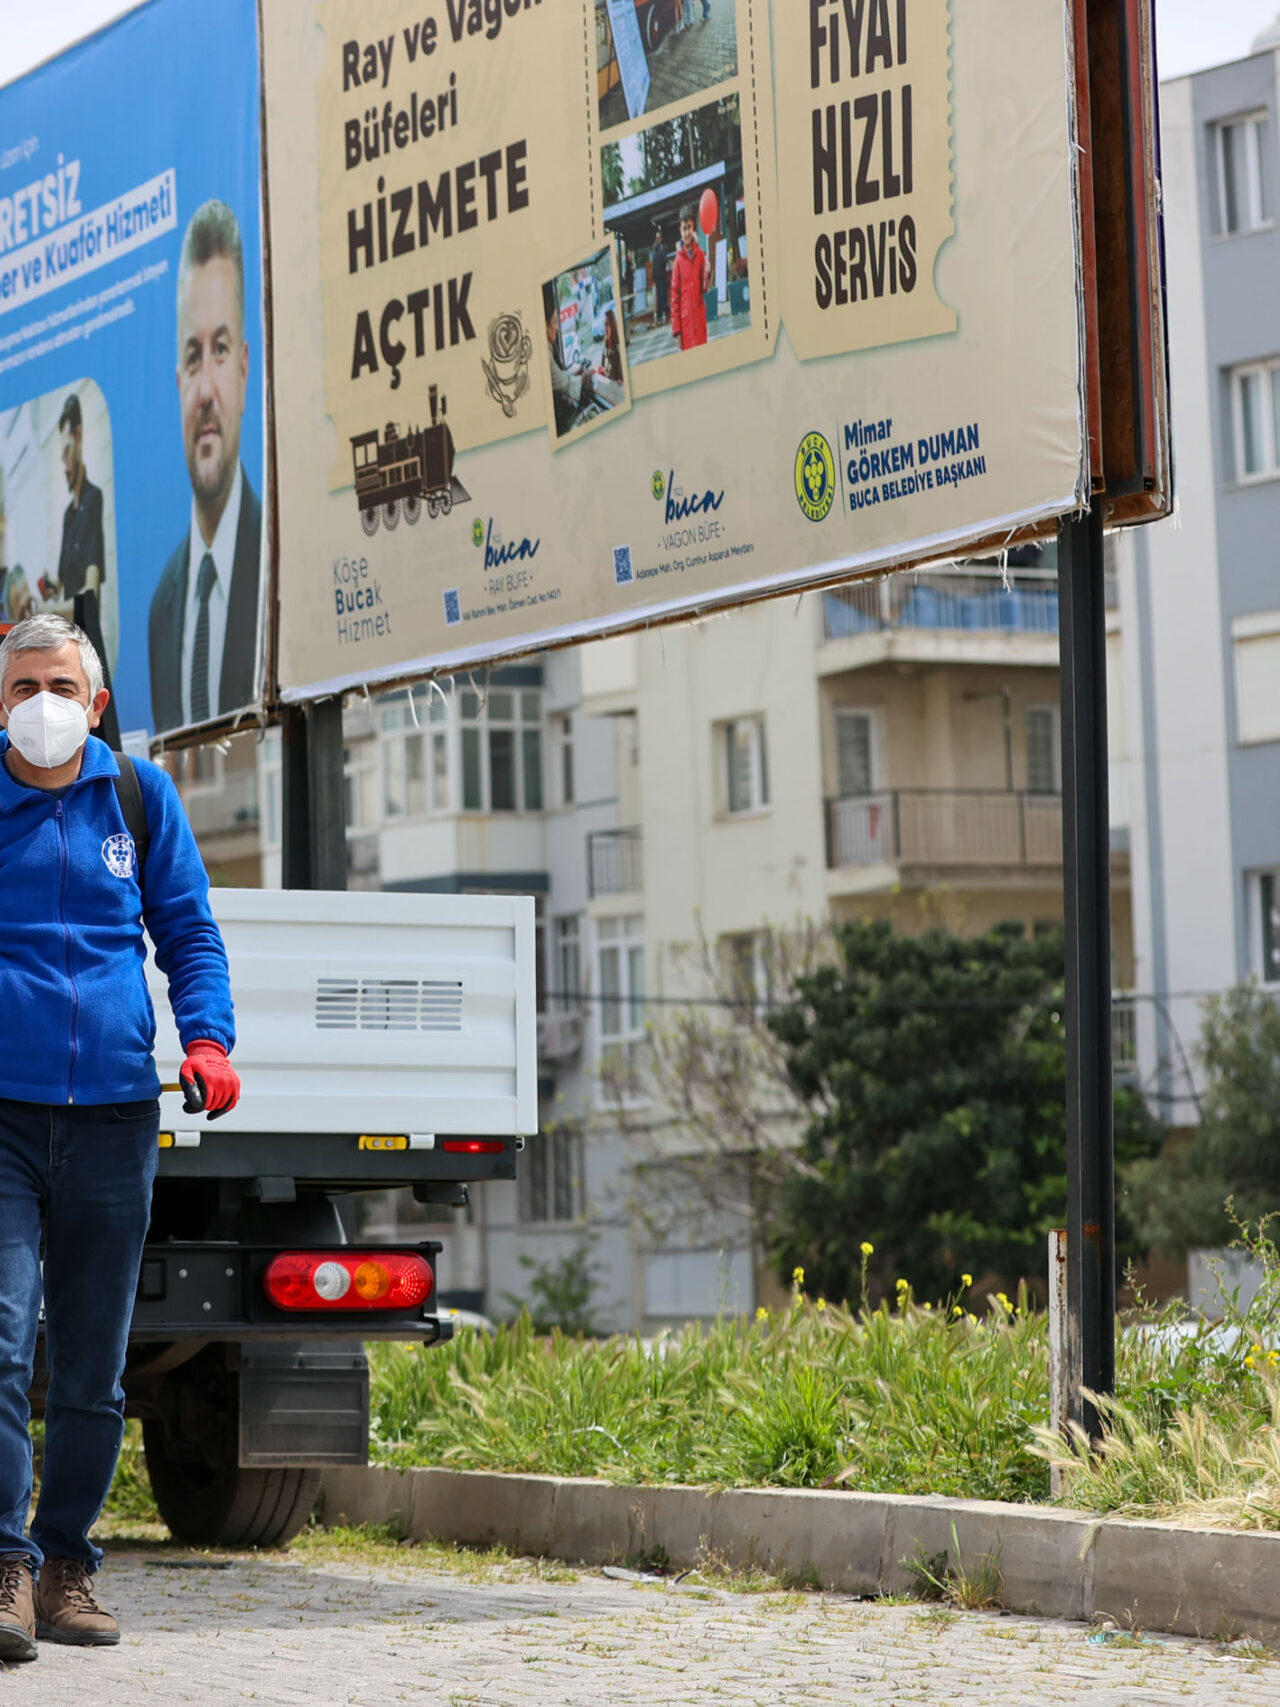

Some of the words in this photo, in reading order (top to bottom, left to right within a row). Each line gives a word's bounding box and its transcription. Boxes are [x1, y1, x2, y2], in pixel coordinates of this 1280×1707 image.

[342, 34, 395, 93] Ray
[403, 16, 438, 63] ve
[446, 0, 543, 43] Vag
[344, 71, 458, 171] Büfeleri
[811, 83, 914, 216] HIZLI
[22, 256, 42, 289] ve
[45, 219, 104, 278] Kuaför
[106, 176, 171, 248] Hizmeti
[346, 138, 530, 275] HİZMETE
[814, 214, 917, 311] SERVİS
[350, 271, 477, 391] AÇTIK
[844, 418, 892, 450] Mimar
[847, 442, 915, 486] GÖRKEM
[918, 422, 980, 464] DUMAN
[665, 469, 725, 525] buca
[849, 486, 880, 511] BUCA
[882, 469, 933, 502] BELEDİYE
[936, 455, 987, 489] BAŞKANI
[483, 517, 540, 572] buca
[662, 528, 697, 551] VAGON
[698, 520, 720, 543] BÜFE
[333, 557, 369, 589] Köşe
[335, 579, 383, 616] Bucak
[488, 577, 505, 596] RAY
[506, 570, 529, 592] BÜFE
[337, 611, 392, 645] Hizmet
